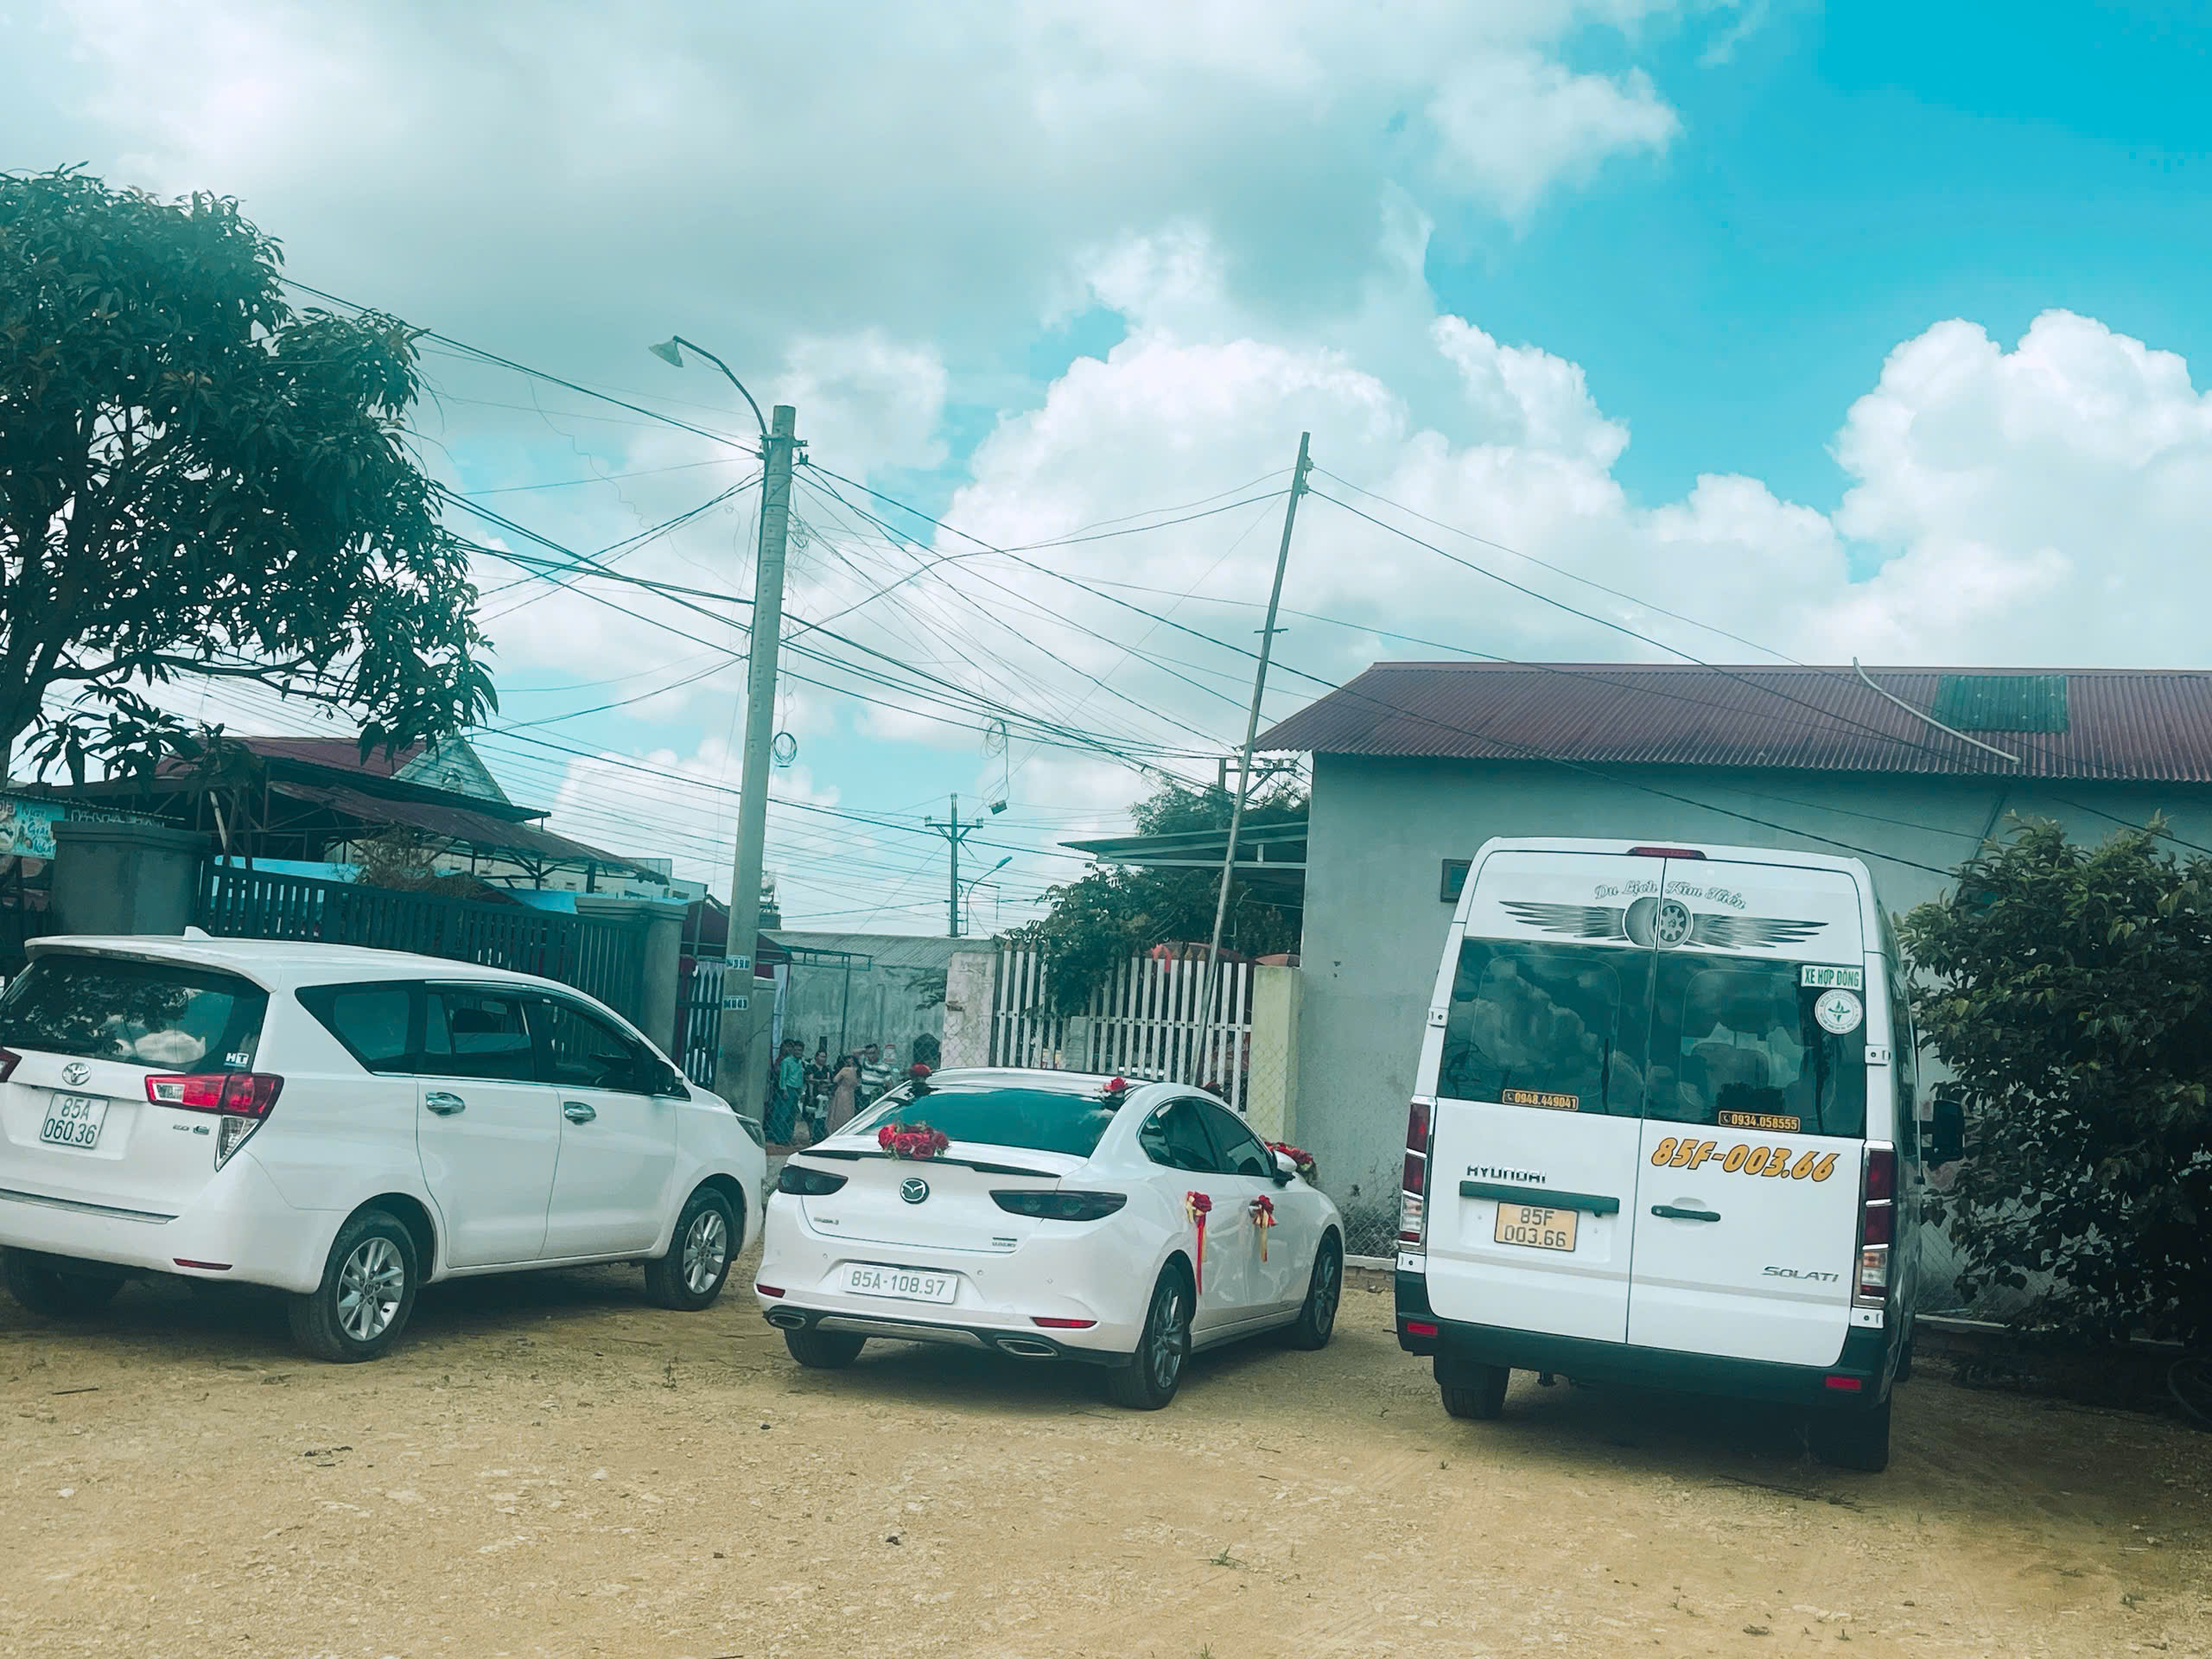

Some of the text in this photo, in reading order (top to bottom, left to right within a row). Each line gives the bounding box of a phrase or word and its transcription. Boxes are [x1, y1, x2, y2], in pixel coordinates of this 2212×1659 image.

[1594, 885, 1619, 899] Du
[1622, 880, 1658, 897] Lịch
[1665, 881, 1703, 898] Kim
[1805, 967, 1815, 983] XE
[226, 1052, 249, 1065] HT
[61, 1097, 91, 1121] 85A
[1514, 1092, 1576, 1109] 0948.449041
[43, 1118, 97, 1145] 060.36
[1732, 1114, 1797, 1130] 0934.058555
[1651, 1137, 1840, 1182] 85F-003.66
[1466, 1166, 1547, 1184] HYUNDAI
[1521, 1207, 1554, 1226] 85F
[1504, 1225, 1567, 1247] 003.66
[851, 1270, 946, 1296] 85A-108.97
[1760, 1267, 1840, 1282] SOLATI
